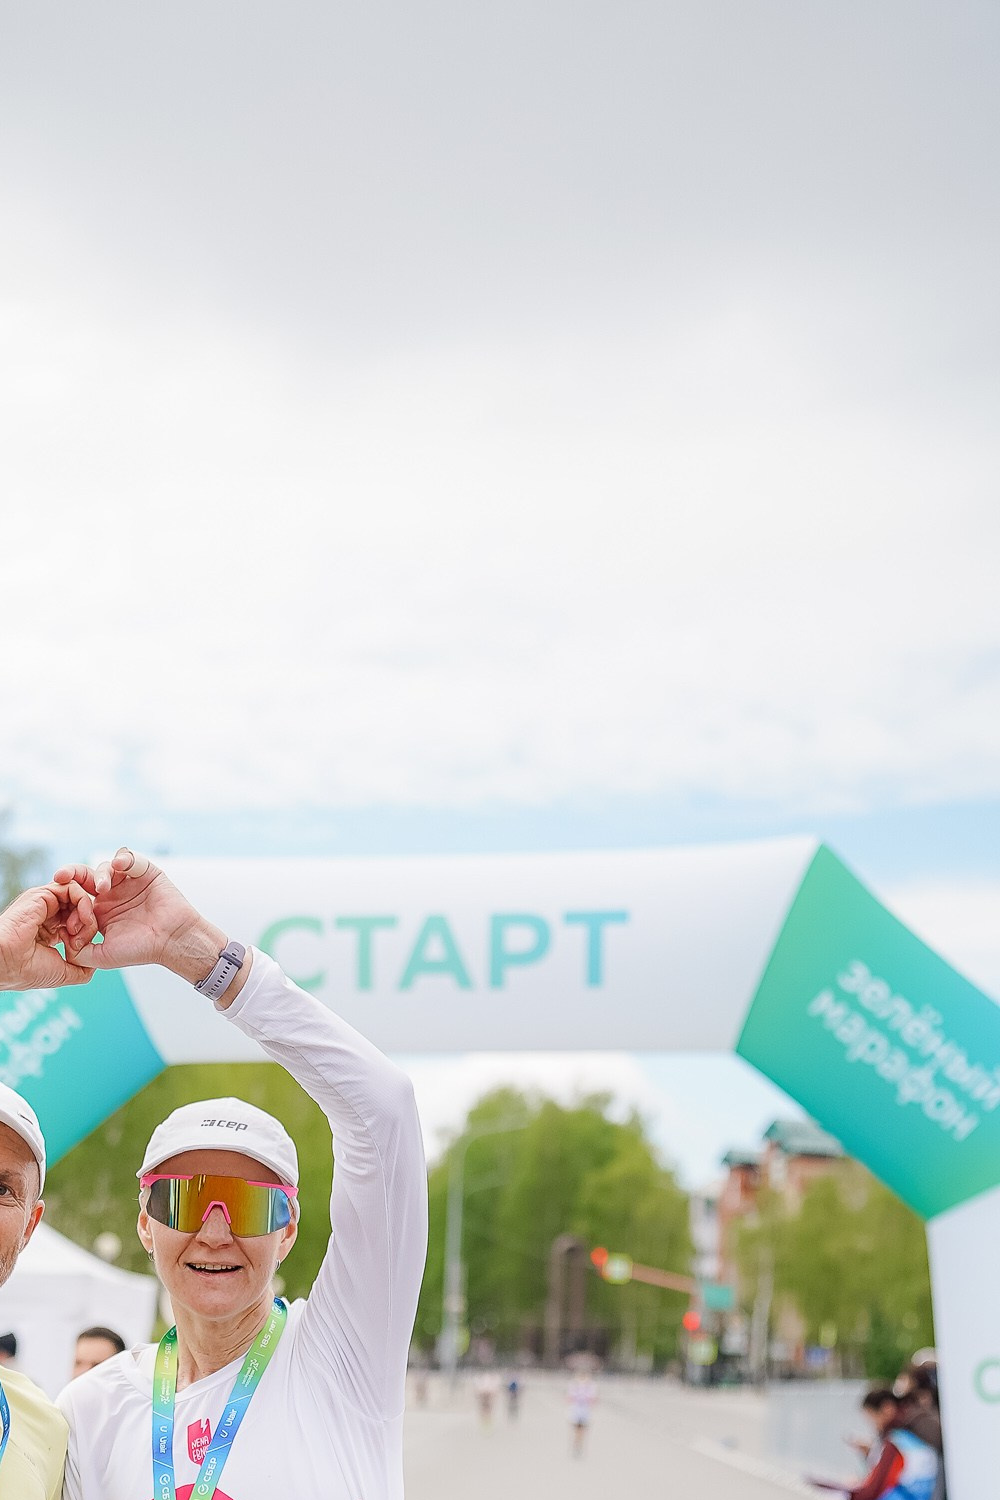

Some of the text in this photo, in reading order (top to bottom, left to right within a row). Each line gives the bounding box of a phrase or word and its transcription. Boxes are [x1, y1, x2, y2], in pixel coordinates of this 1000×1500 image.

[258, 910, 630, 991] СТАРТ
[217, 1120, 248, 1131] cep
[260, 1333, 271, 1348] 185
[224, 1408, 238, 1427] Utair
[160, 1436, 168, 1454] Utair
[204, 1457, 217, 1482] СБЕР
